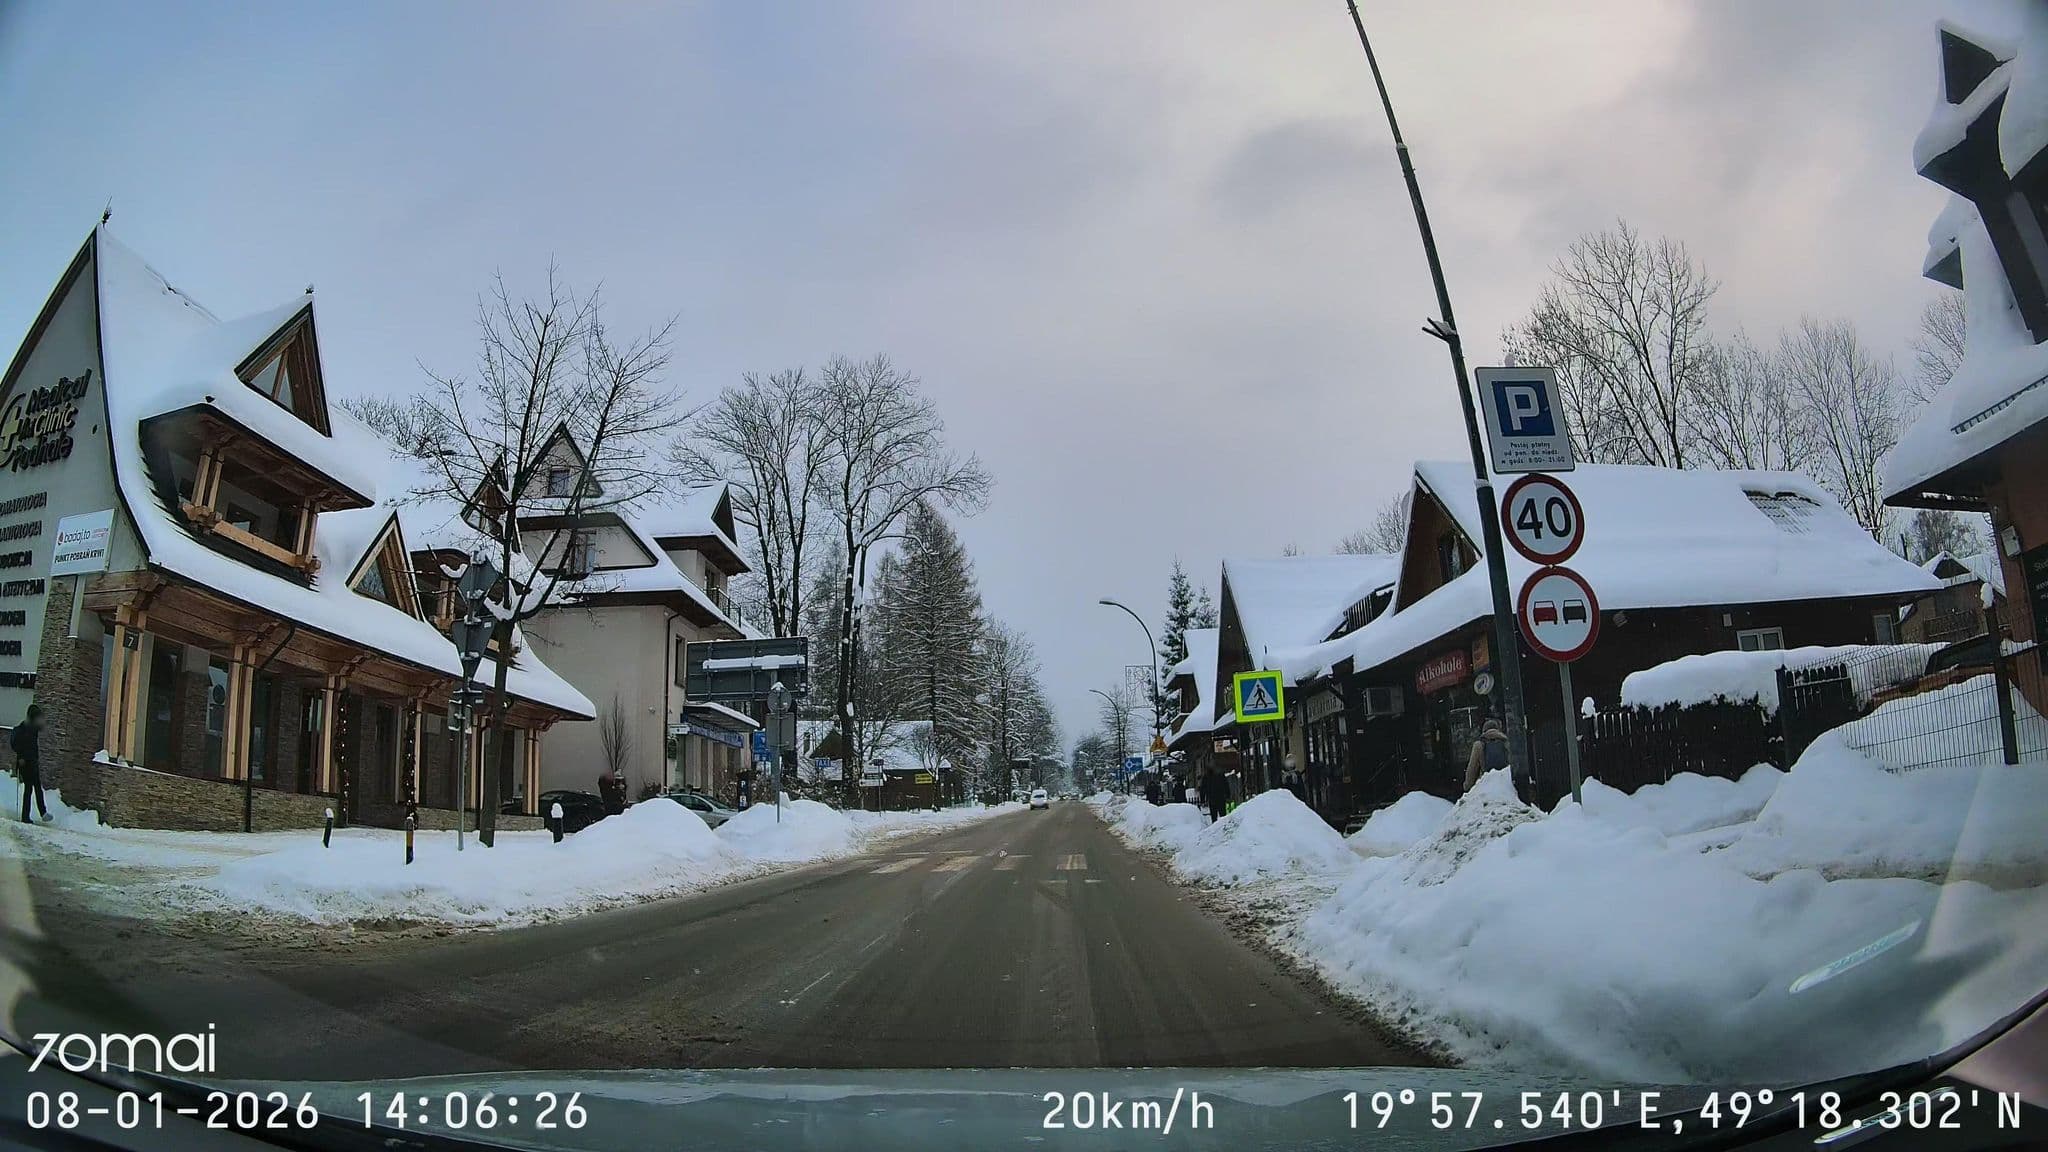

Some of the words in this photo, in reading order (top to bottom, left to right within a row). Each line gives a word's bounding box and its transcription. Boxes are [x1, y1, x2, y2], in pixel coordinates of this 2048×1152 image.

[26, 368, 92, 416] Medical
[1505, 386, 1540, 430] P
[11, 431, 73, 473] Podhale
[1517, 496, 1572, 540] 40
[55, 553, 69, 564] PUNKT
[128, 636, 134, 647] 7
[1419, 657, 1463, 685] Alkohole
[815, 759, 831, 768] TAXI
